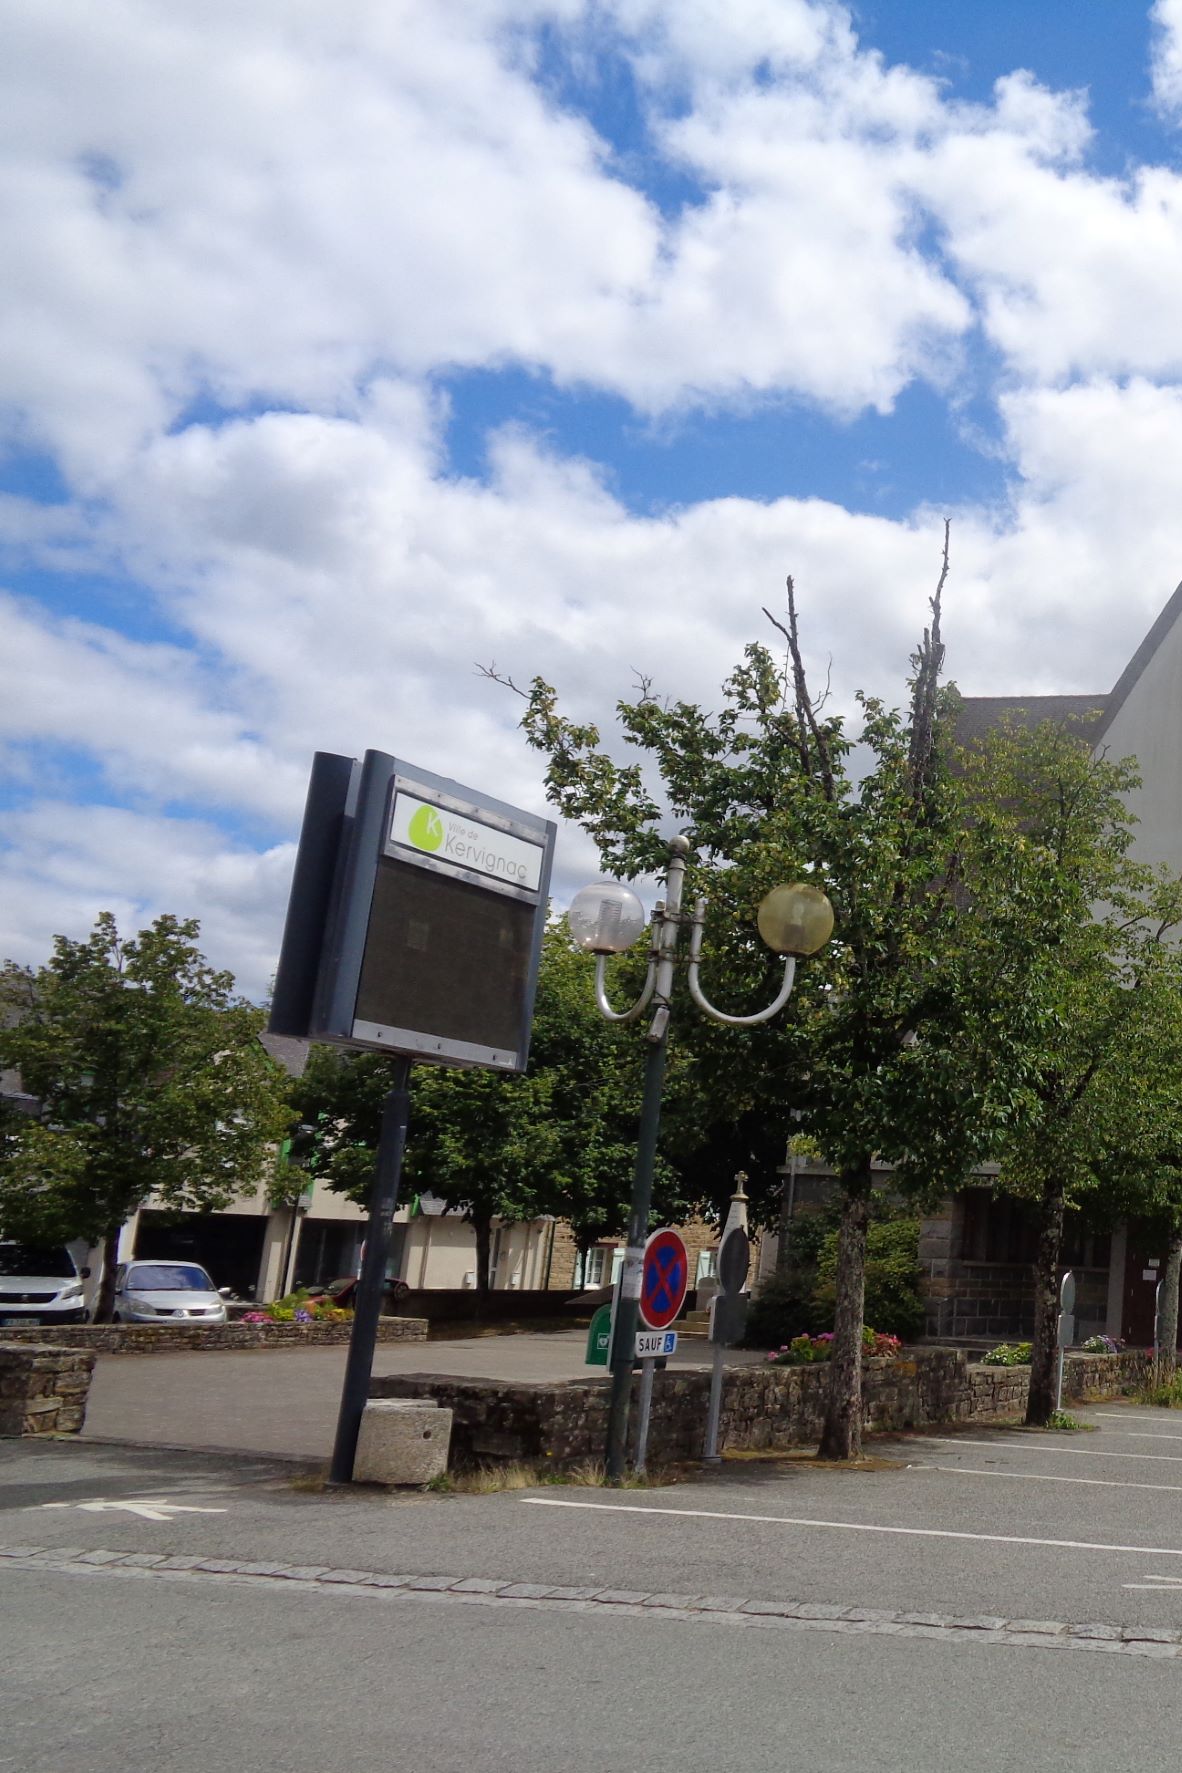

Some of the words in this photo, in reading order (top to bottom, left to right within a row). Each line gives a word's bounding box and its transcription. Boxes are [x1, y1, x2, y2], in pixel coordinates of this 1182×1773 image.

[426, 811, 439, 837] K
[448, 822, 466, 836] Ville
[467, 831, 479, 841] de
[445, 834, 528, 880] Kervignac
[639, 1337, 662, 1352] SAUF
